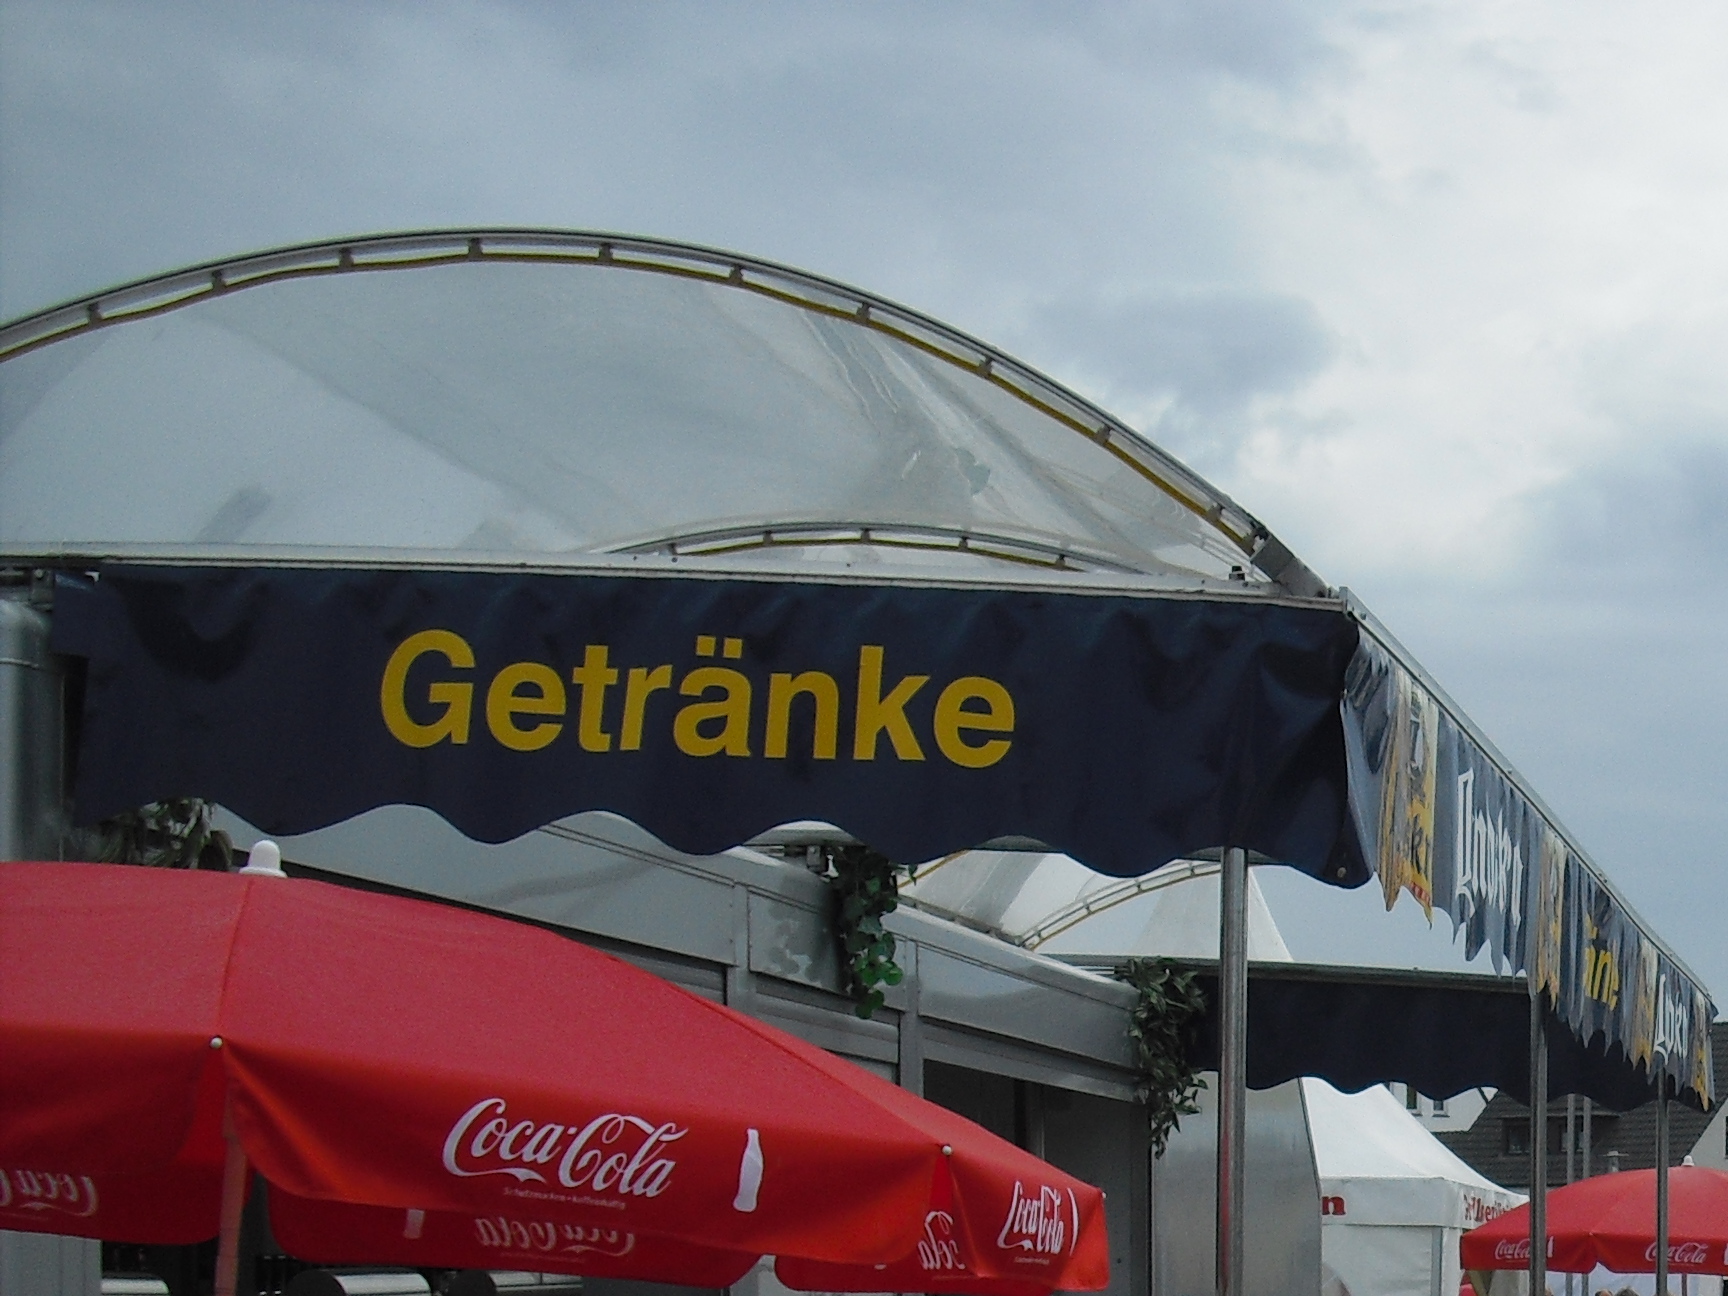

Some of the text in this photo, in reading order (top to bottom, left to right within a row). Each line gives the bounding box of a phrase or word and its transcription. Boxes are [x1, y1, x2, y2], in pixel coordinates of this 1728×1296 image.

[381, 628, 1016, 769] Getränke
[441, 1097, 689, 1199] Coca-Cola
[1494, 1238, 1531, 1260] Coca-Col
[1645, 1241, 1709, 1264] Ca-Cola
